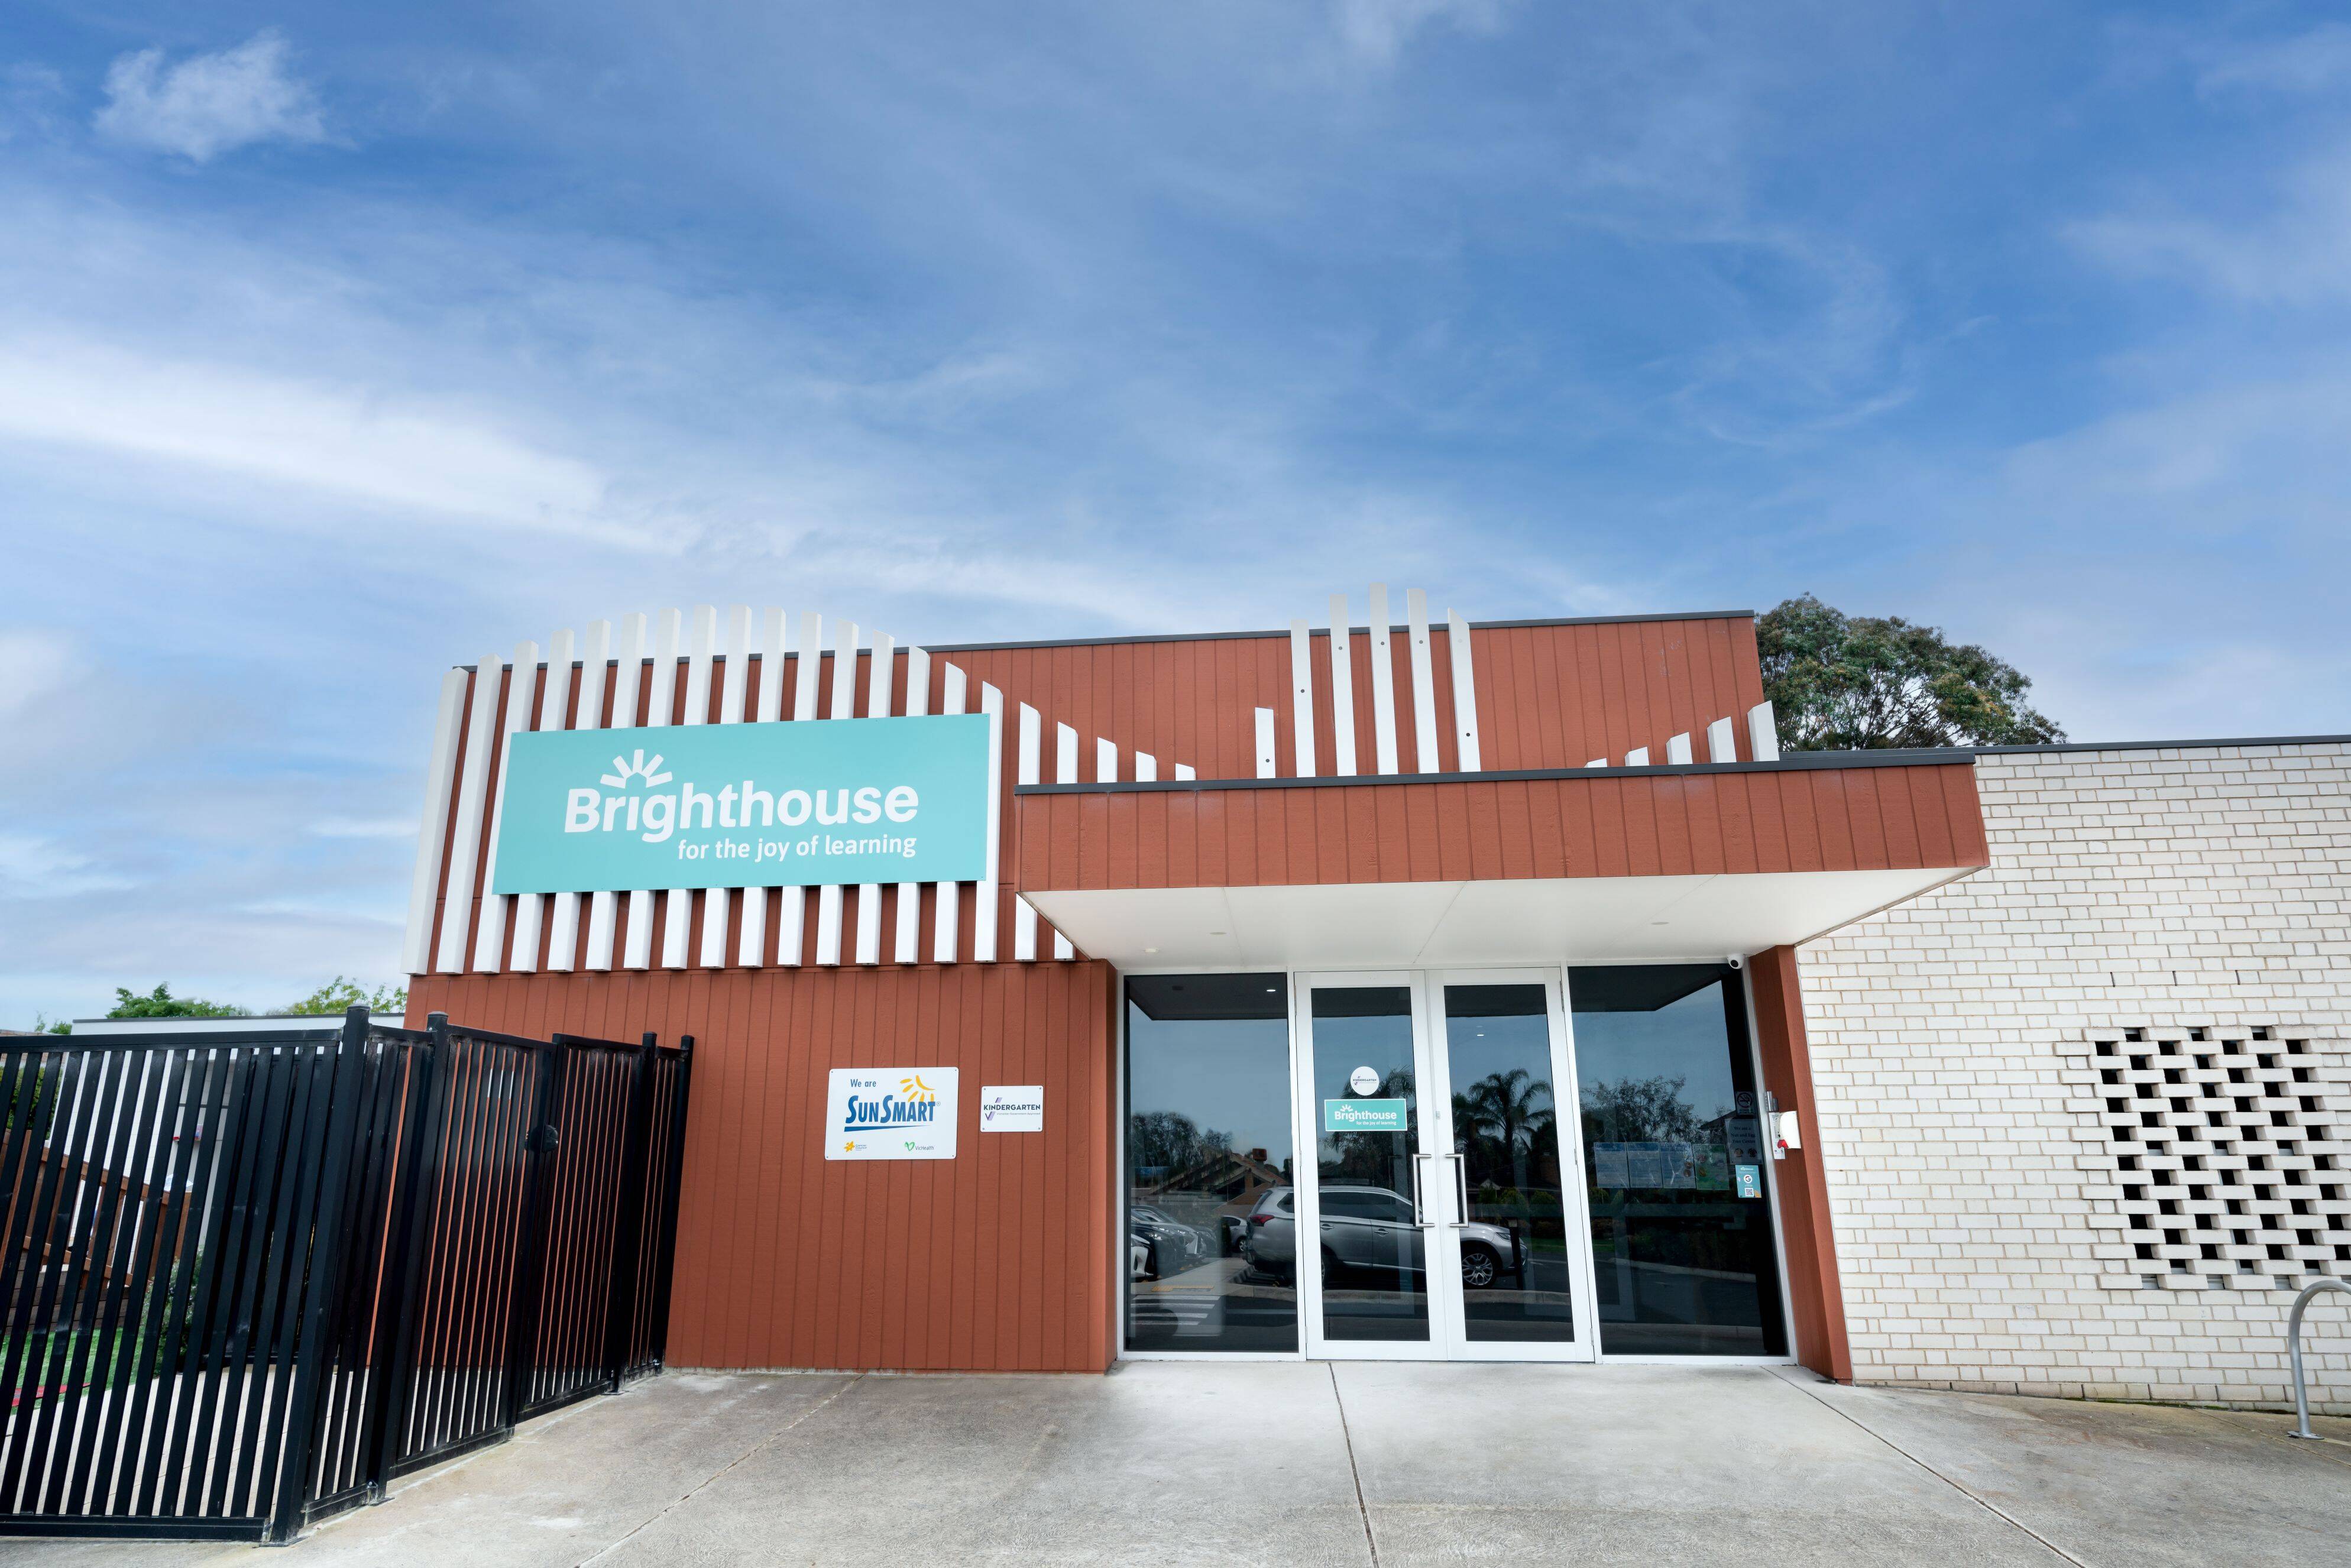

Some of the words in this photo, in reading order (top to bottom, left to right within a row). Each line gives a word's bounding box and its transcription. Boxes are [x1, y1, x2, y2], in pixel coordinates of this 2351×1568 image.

[565, 780, 919, 843] Brighthouse
[678, 839, 709, 860] for
[715, 838, 750, 858] the
[754, 837, 790, 863] joy
[796, 835, 819, 856] of
[825, 834, 917, 858] learning
[850, 1078, 862, 1087] We
[1334, 1110, 1397, 1122] Brighthouse
